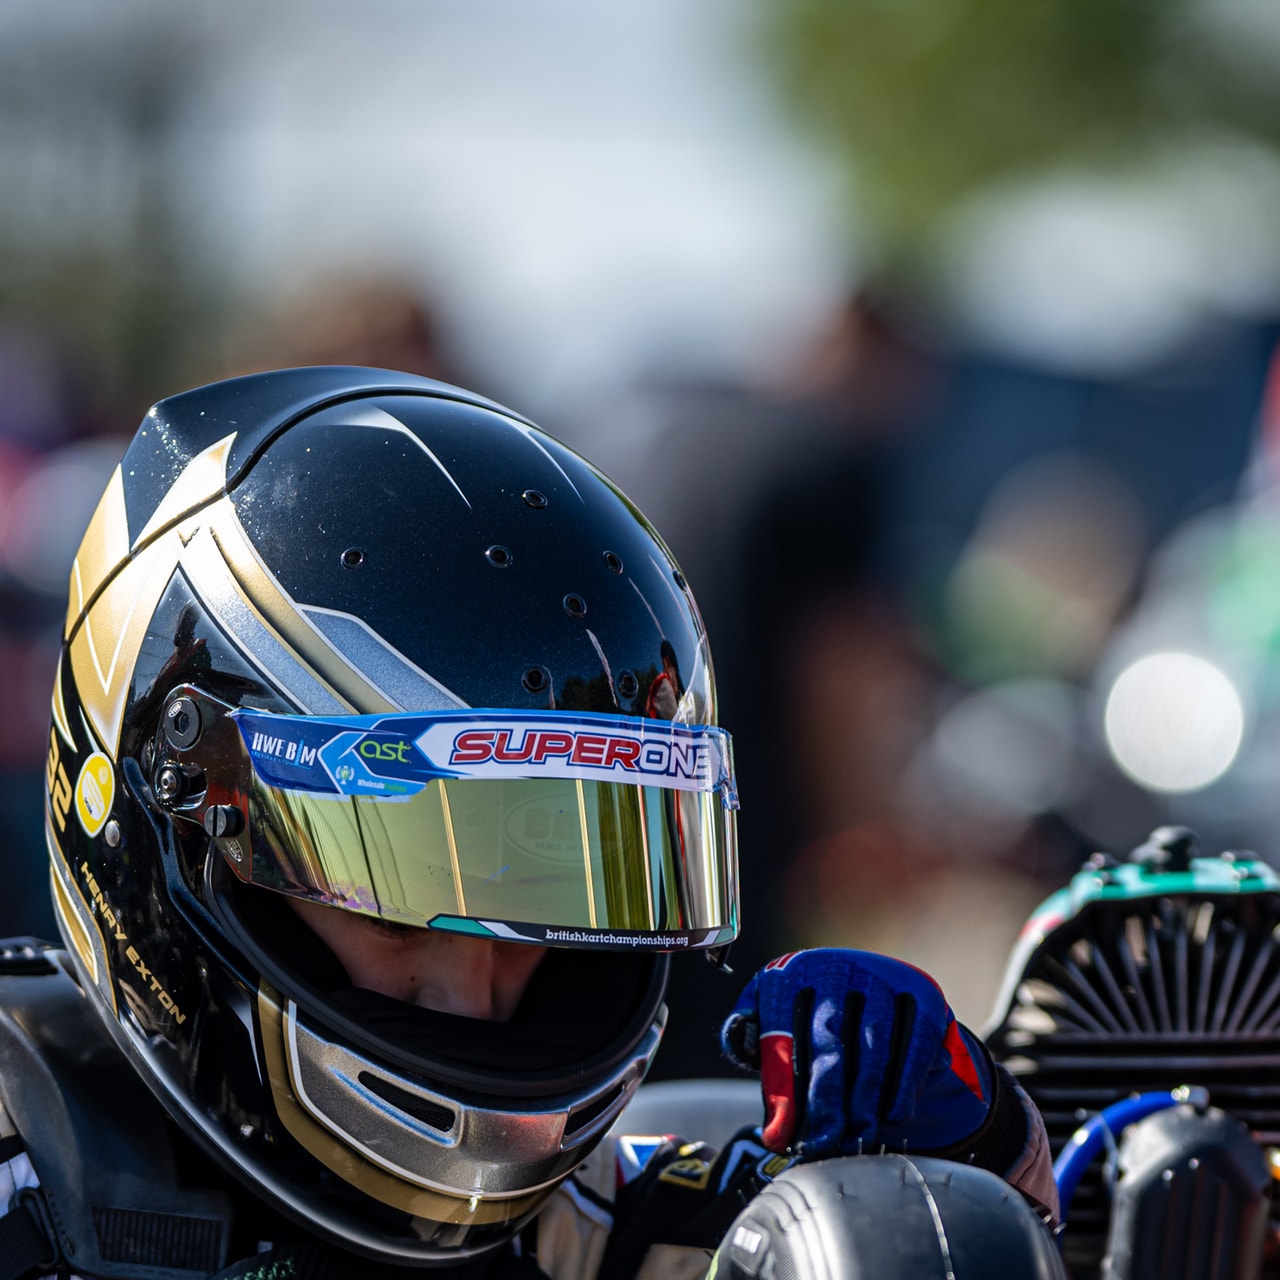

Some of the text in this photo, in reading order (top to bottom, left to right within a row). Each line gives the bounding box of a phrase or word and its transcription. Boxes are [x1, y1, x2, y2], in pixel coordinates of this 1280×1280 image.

[251, 732, 286, 759] HWE
[81, 861, 187, 1025] HENRY EXTON
[545, 929, 689, 948] britishkartchampionships.org
